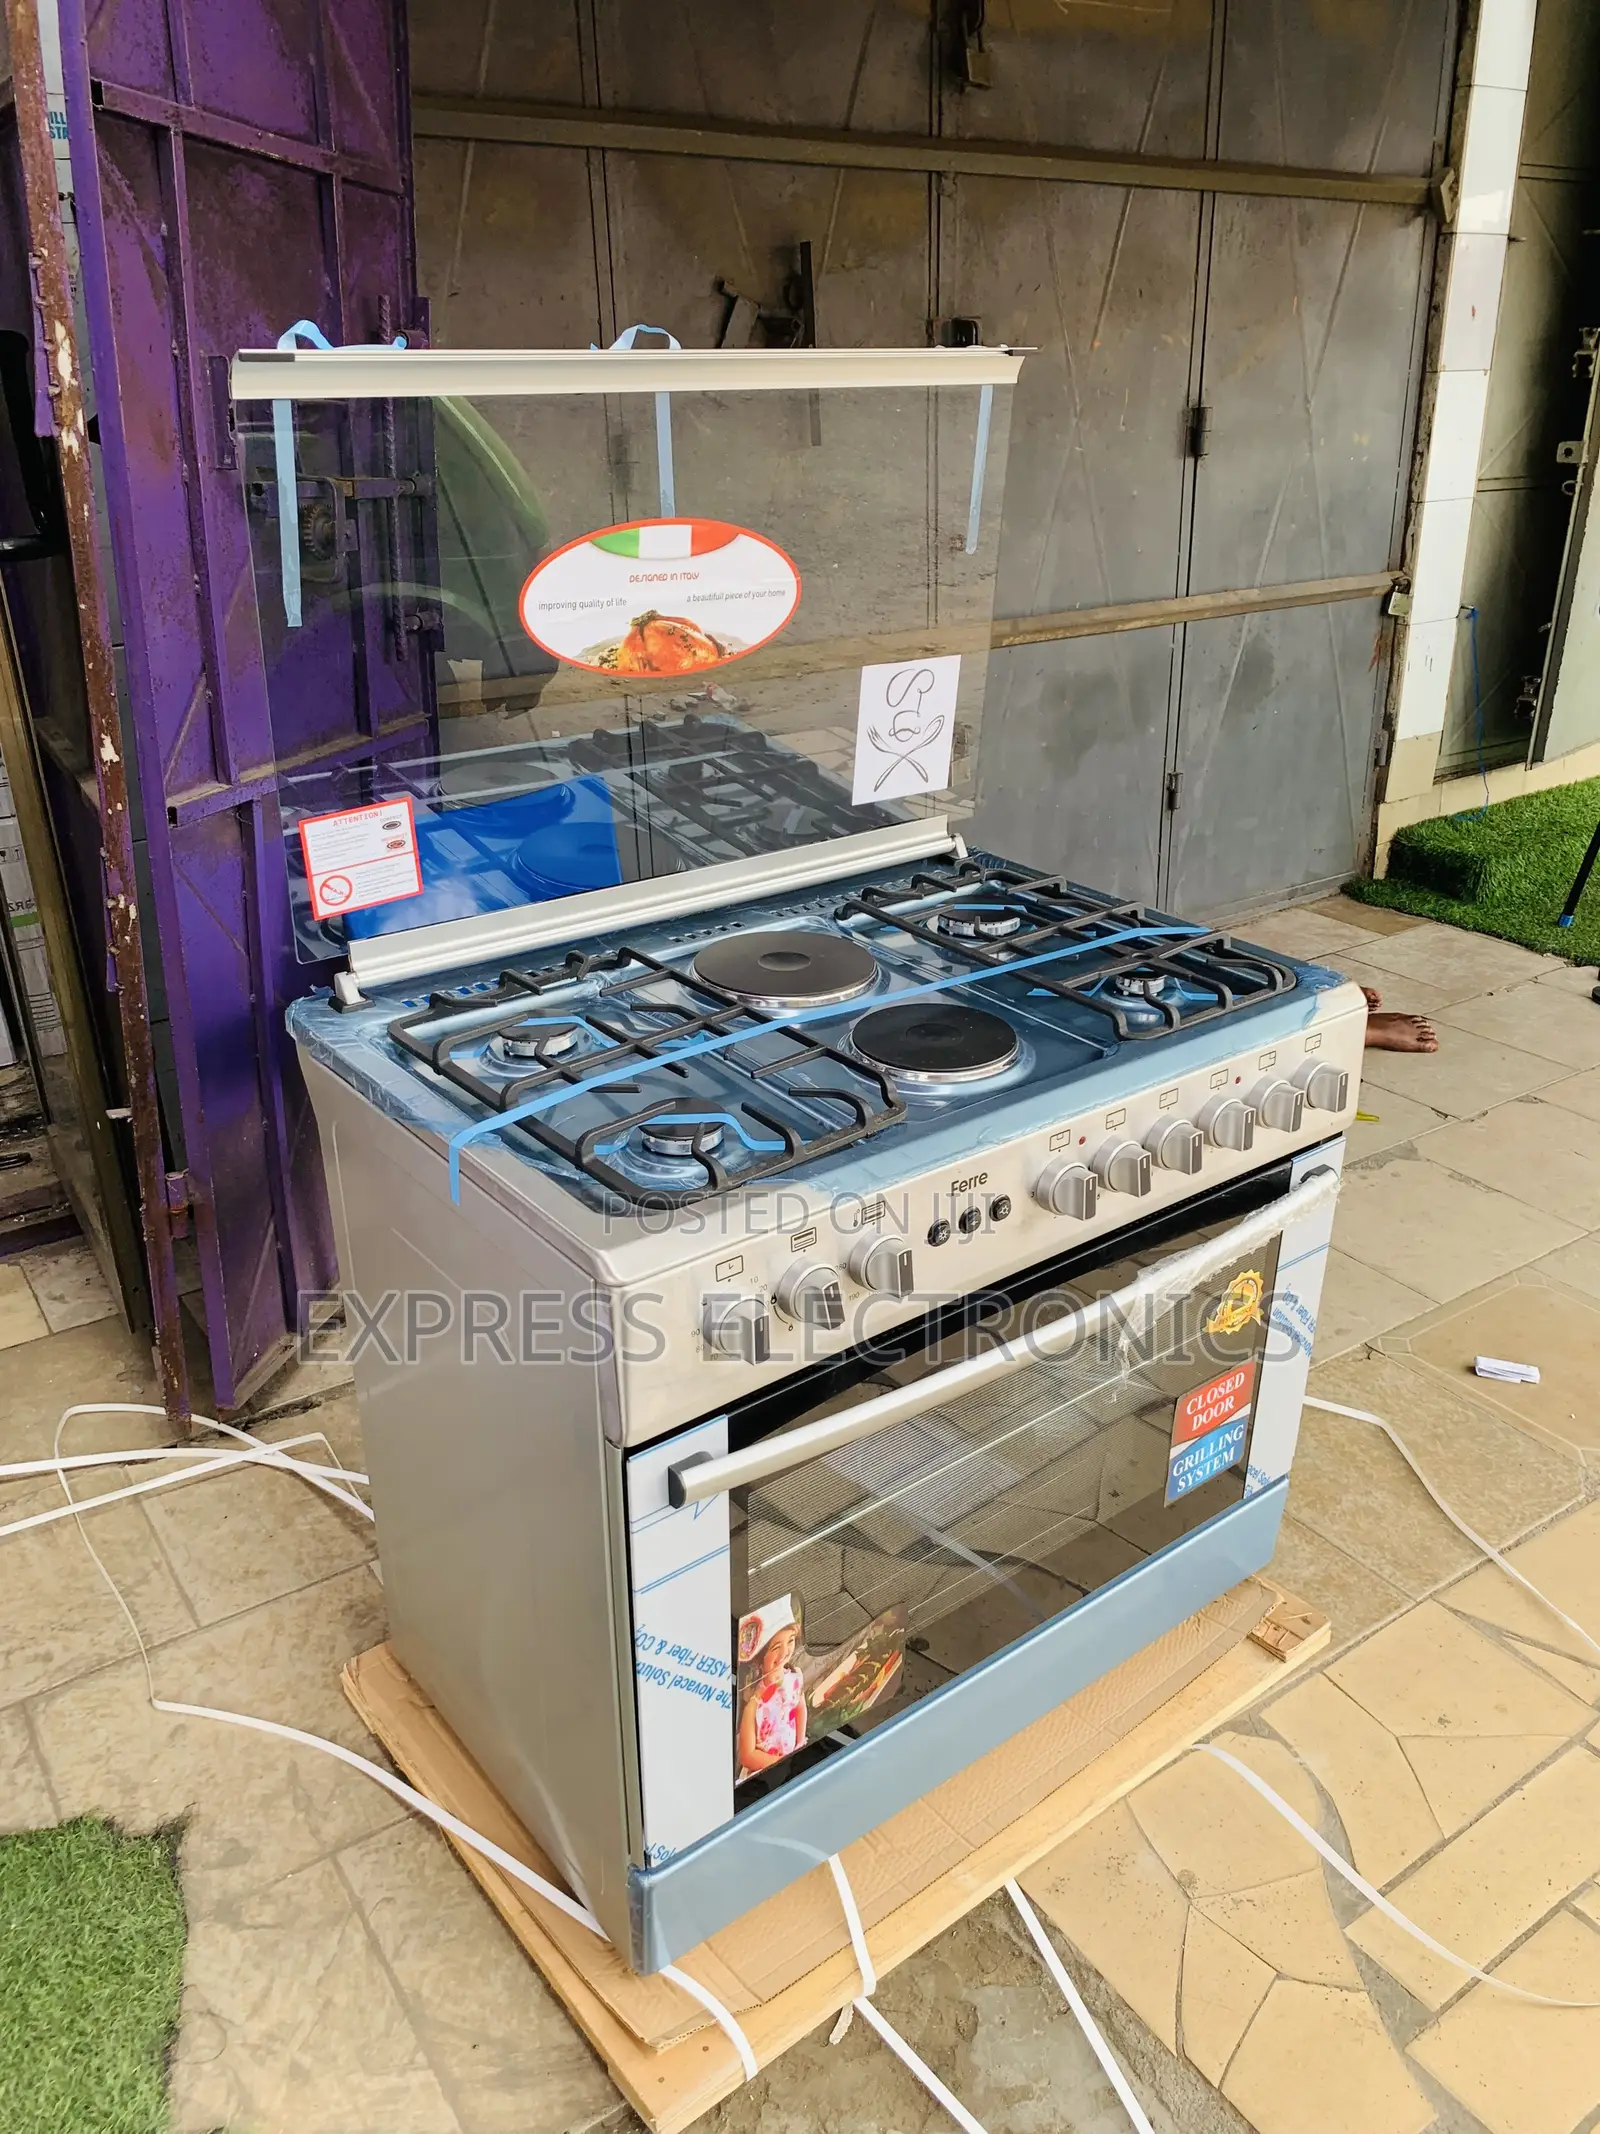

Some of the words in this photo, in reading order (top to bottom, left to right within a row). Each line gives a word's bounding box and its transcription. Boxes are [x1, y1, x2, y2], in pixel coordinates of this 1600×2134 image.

[629, 573, 668, 583] DESIGNED
[670, 572, 678, 581] IN
[680, 572, 700, 581] ITALY
[686, 595, 691, 603] a
[725, 591, 743, 601] piece
[744, 590, 751, 600] of
[751, 590, 767, 600] your
[768, 588, 786, 597] home
[538, 600, 577, 612] improving
[578, 598, 604, 610] quality
[606, 597, 614, 607] of
[615, 597, 627, 607] life
[333, 810, 383, 827] ATTENTION!
[951, 1172, 988, 1197] Ferre
[750, 1276, 759, 1285] 10
[759, 1284, 768, 1293] 20
[691, 1328, 700, 1338] 90
[1186, 1372, 1245, 1415] CLOSED
[1191, 1395, 1235, 1432] DOOR
[1173, 1424, 1244, 1477] GRILLING
[1176, 1446, 1236, 1493] SYSTEM
[654, 1639, 668, 1656] &
[666, 1643, 699, 1668] Fiber
[666, 1674, 717, 1702] Novacel
